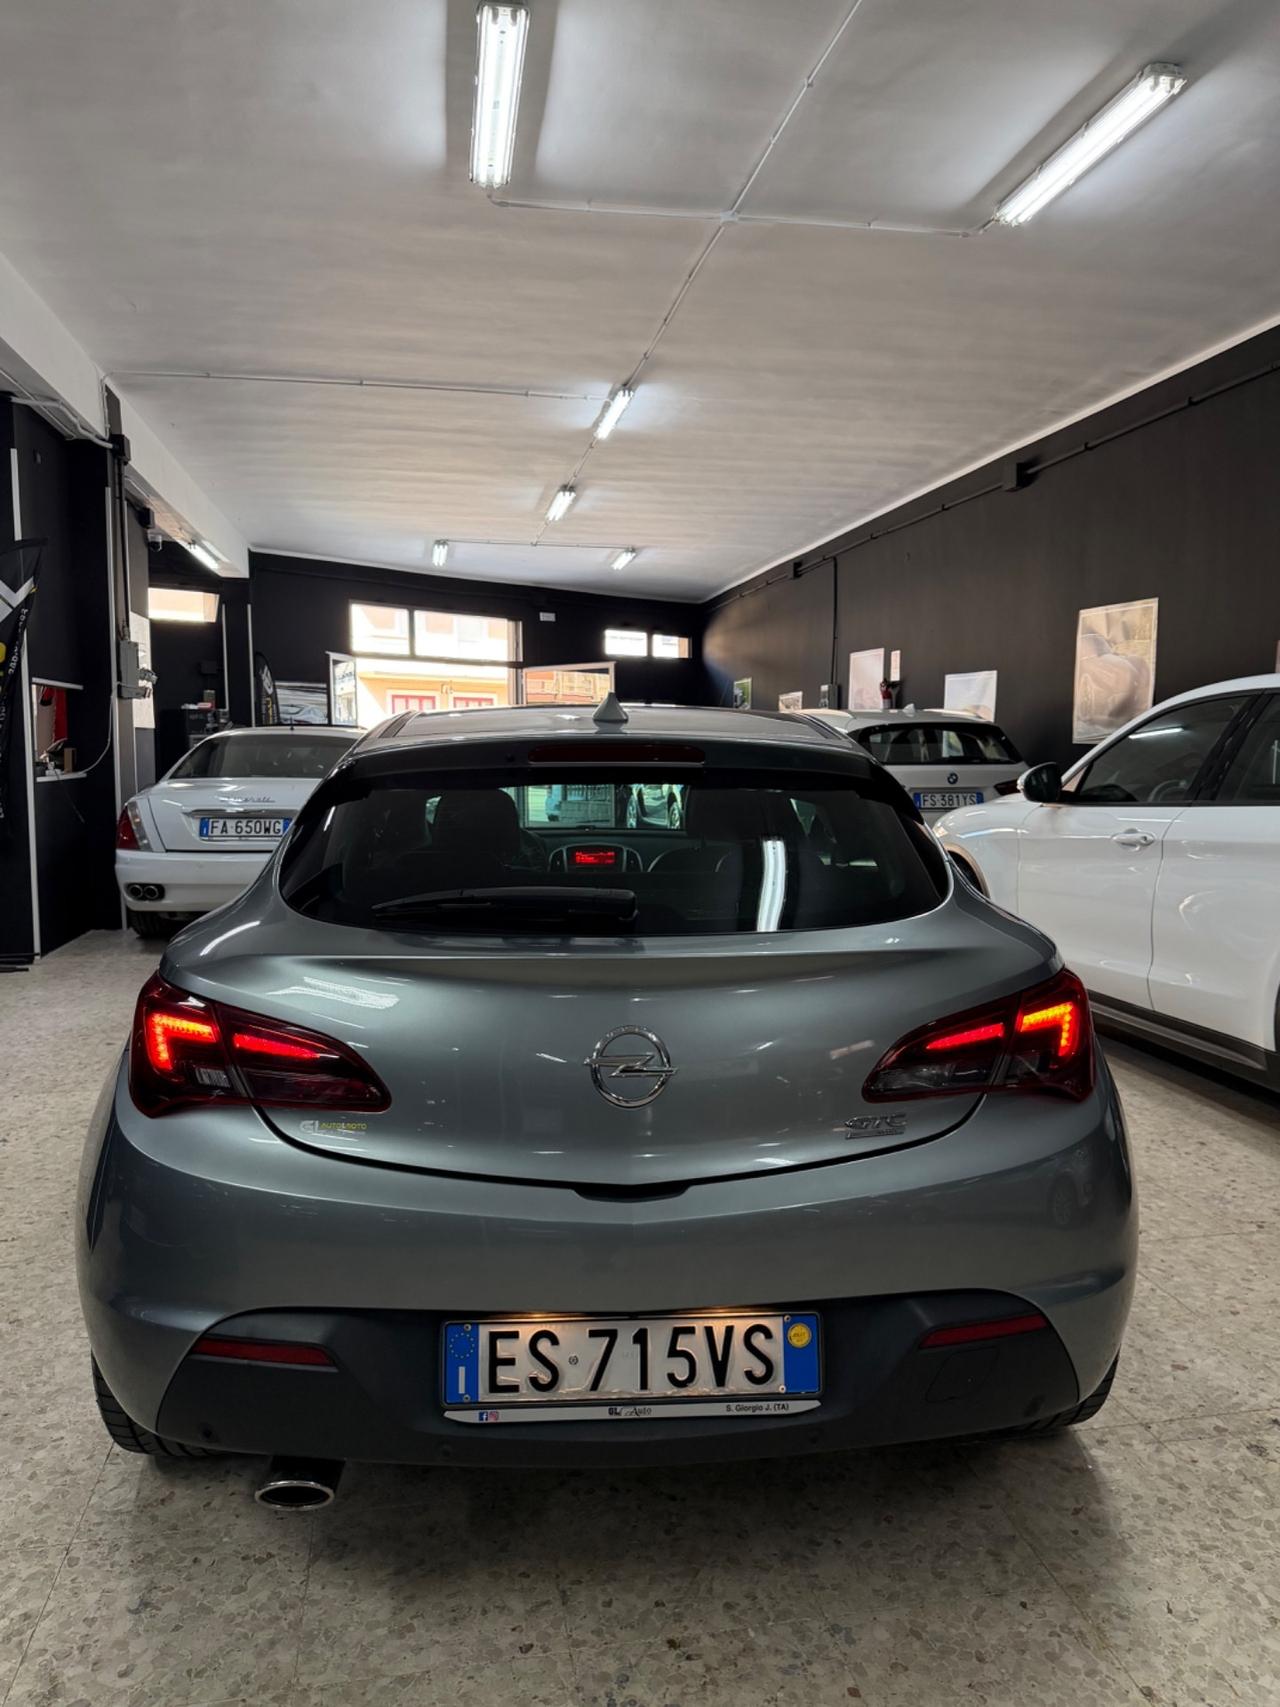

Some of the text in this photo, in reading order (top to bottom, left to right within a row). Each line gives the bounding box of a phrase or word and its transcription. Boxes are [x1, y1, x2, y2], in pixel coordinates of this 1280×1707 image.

[922, 794, 976, 807] FS 381YS
[211, 820, 281, 835] FA 650WG
[487, 1323, 775, 1394] ES 715VS
[735, 1403, 764, 1413] Giorgio
[773, 1402, 790, 1412] (TA)
